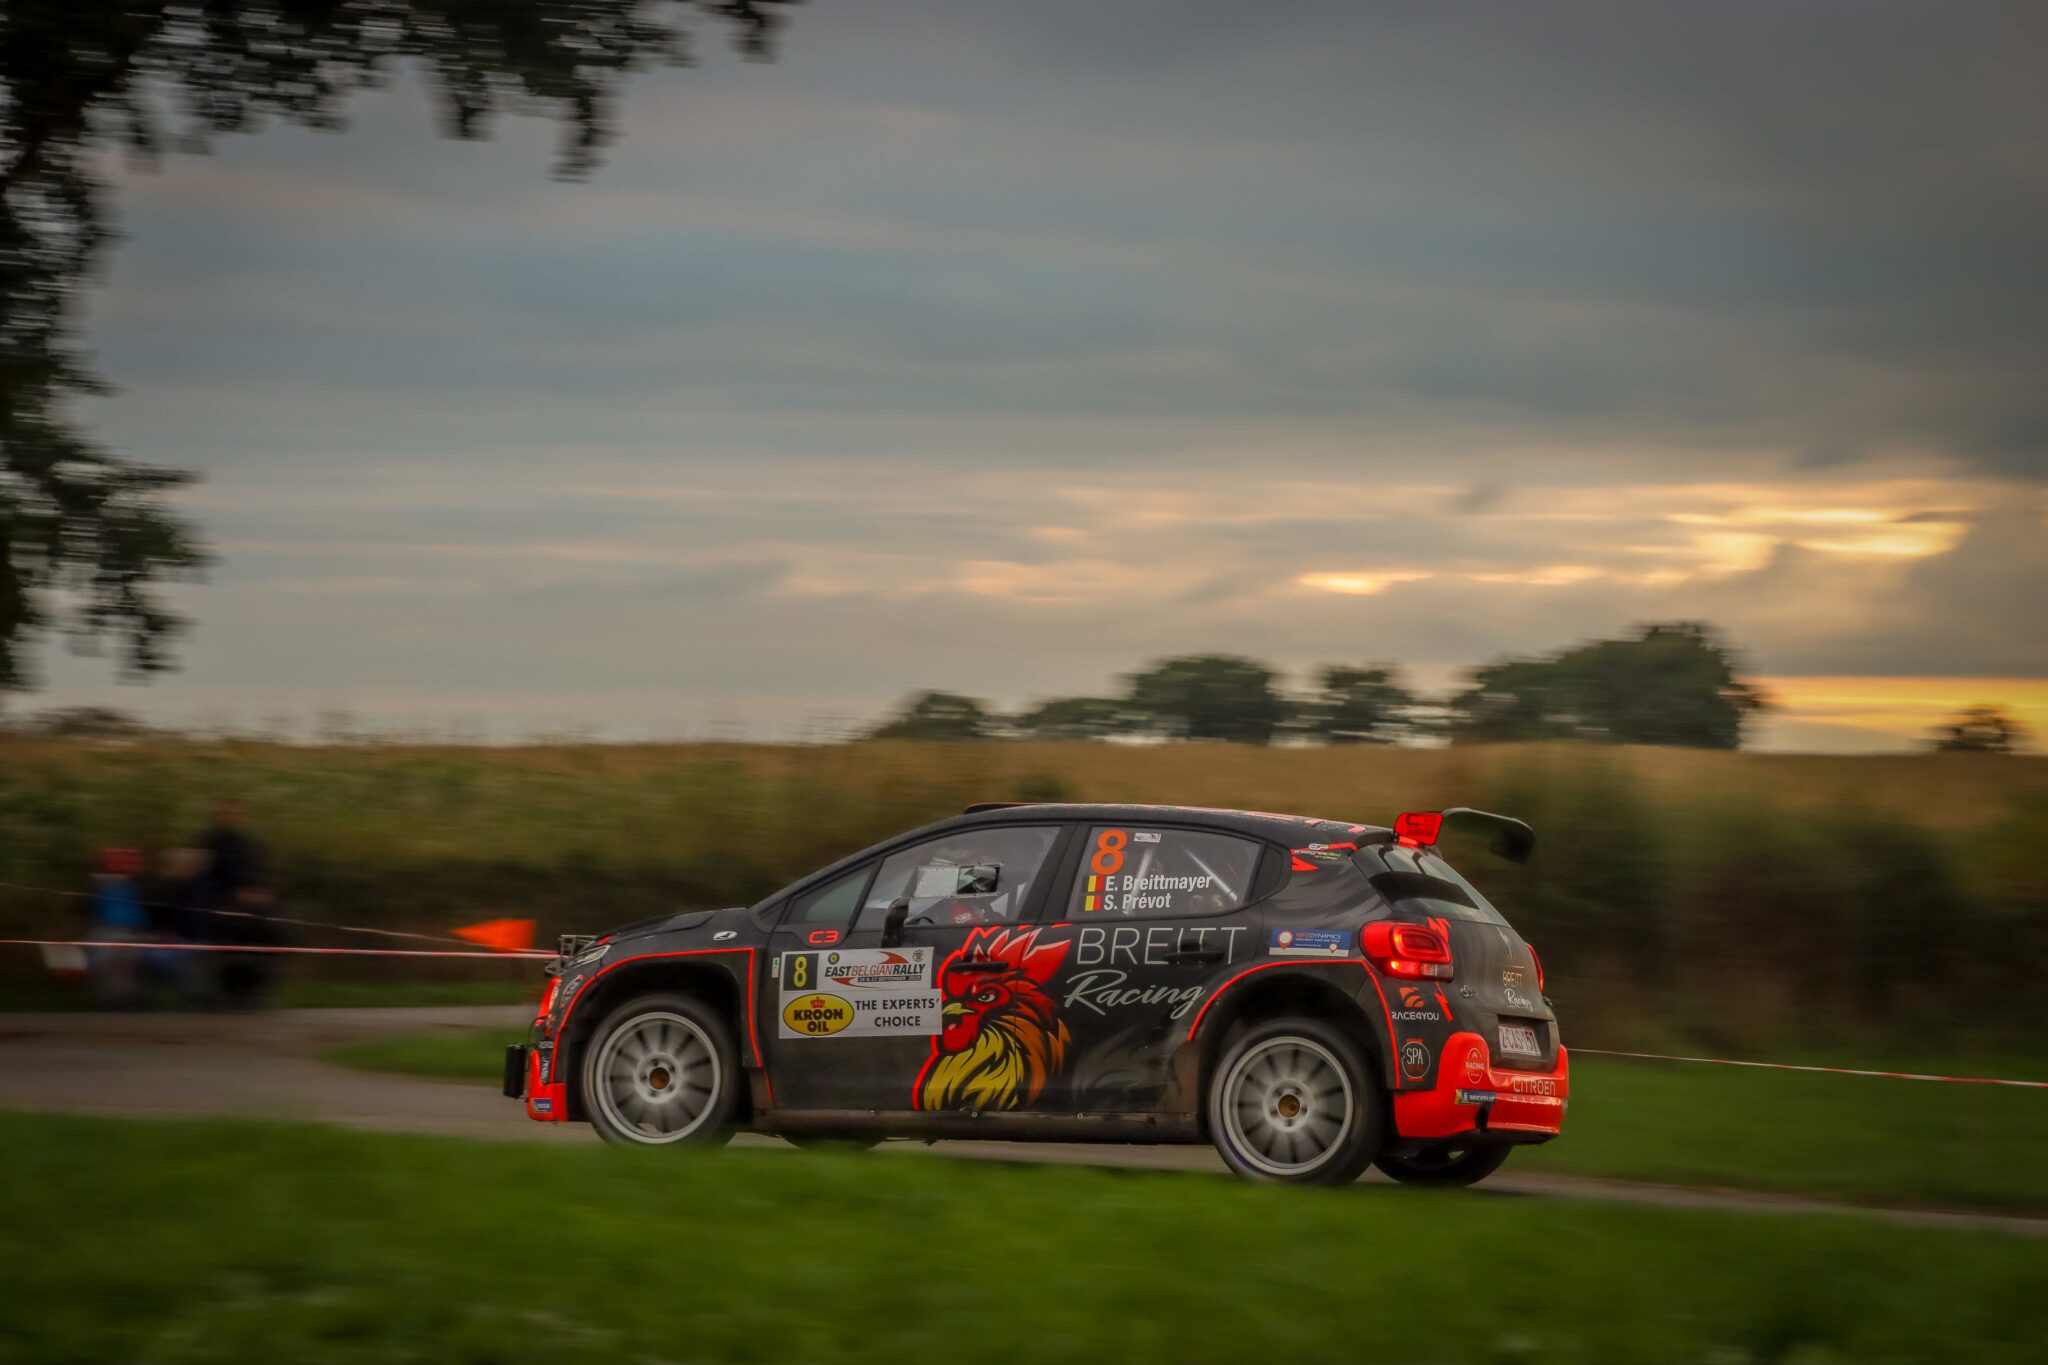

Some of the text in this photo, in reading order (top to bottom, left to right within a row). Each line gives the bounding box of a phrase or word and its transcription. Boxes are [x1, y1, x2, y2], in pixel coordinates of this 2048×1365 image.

[1090, 829, 1128, 876] 8
[1105, 874, 1213, 893] E. Breittmayer
[1103, 892, 1172, 910] S. Prévot
[808, 930, 839, 944] C3
[1076, 926, 1248, 965] BREITT
[793, 955, 808, 988] 8
[1063, 969, 1206, 1020] Racing
[855, 1000, 877, 1011] THE
[793, 1009, 844, 1022] KROON
[874, 1016, 921, 1028] CHOICE
[1391, 1011, 1440, 1021] RACE4YOU
[807, 1021, 829, 1033] OIL
[1406, 1047, 1424, 1065] SPA
[1465, 1062, 1485, 1071] RACING
